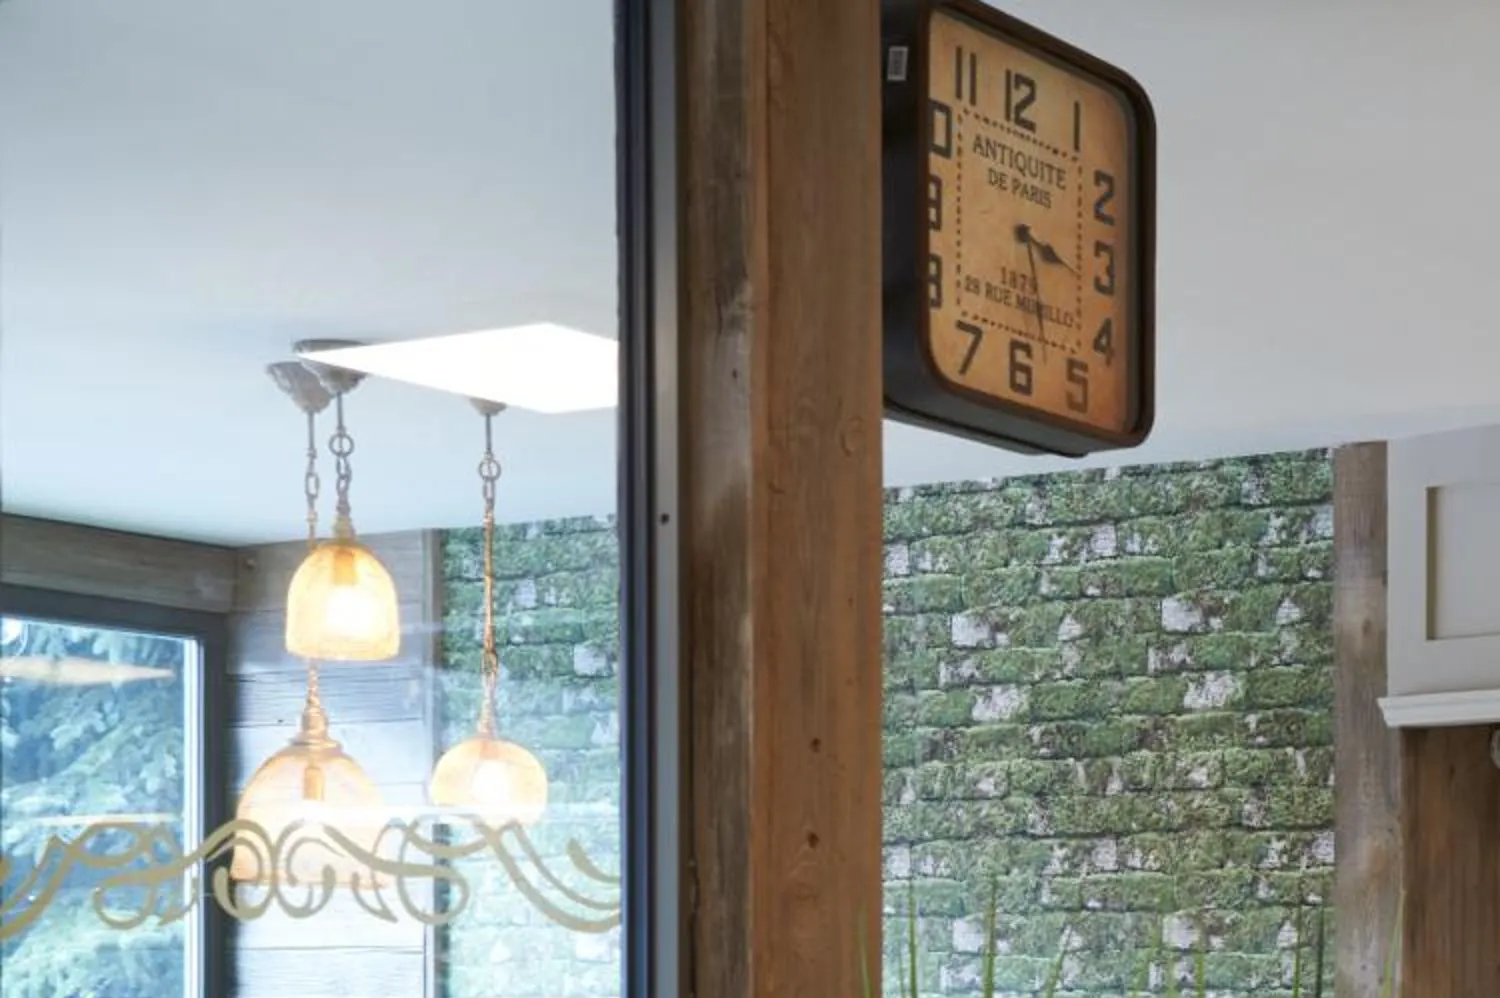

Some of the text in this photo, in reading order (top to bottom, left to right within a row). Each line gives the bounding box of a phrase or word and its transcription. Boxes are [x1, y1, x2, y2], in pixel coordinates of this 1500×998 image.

[954, 46, 978, 106] 11
[1004, 69, 1037, 134] 12
[1073, 101, 1082, 152] 1
[973, 134, 1067, 190] ANTIQUITE
[988, 167, 1052, 209] DE PARIS
[1093, 170, 1116, 226] 2
[985, 281, 1012, 307] RUE
[1093, 240, 1116, 296] 3
[955, 319, 983, 376] 7
[1009, 340, 1034, 397] 6
[1092, 318, 1116, 367] 4
[1066, 357, 1089, 414] 5
